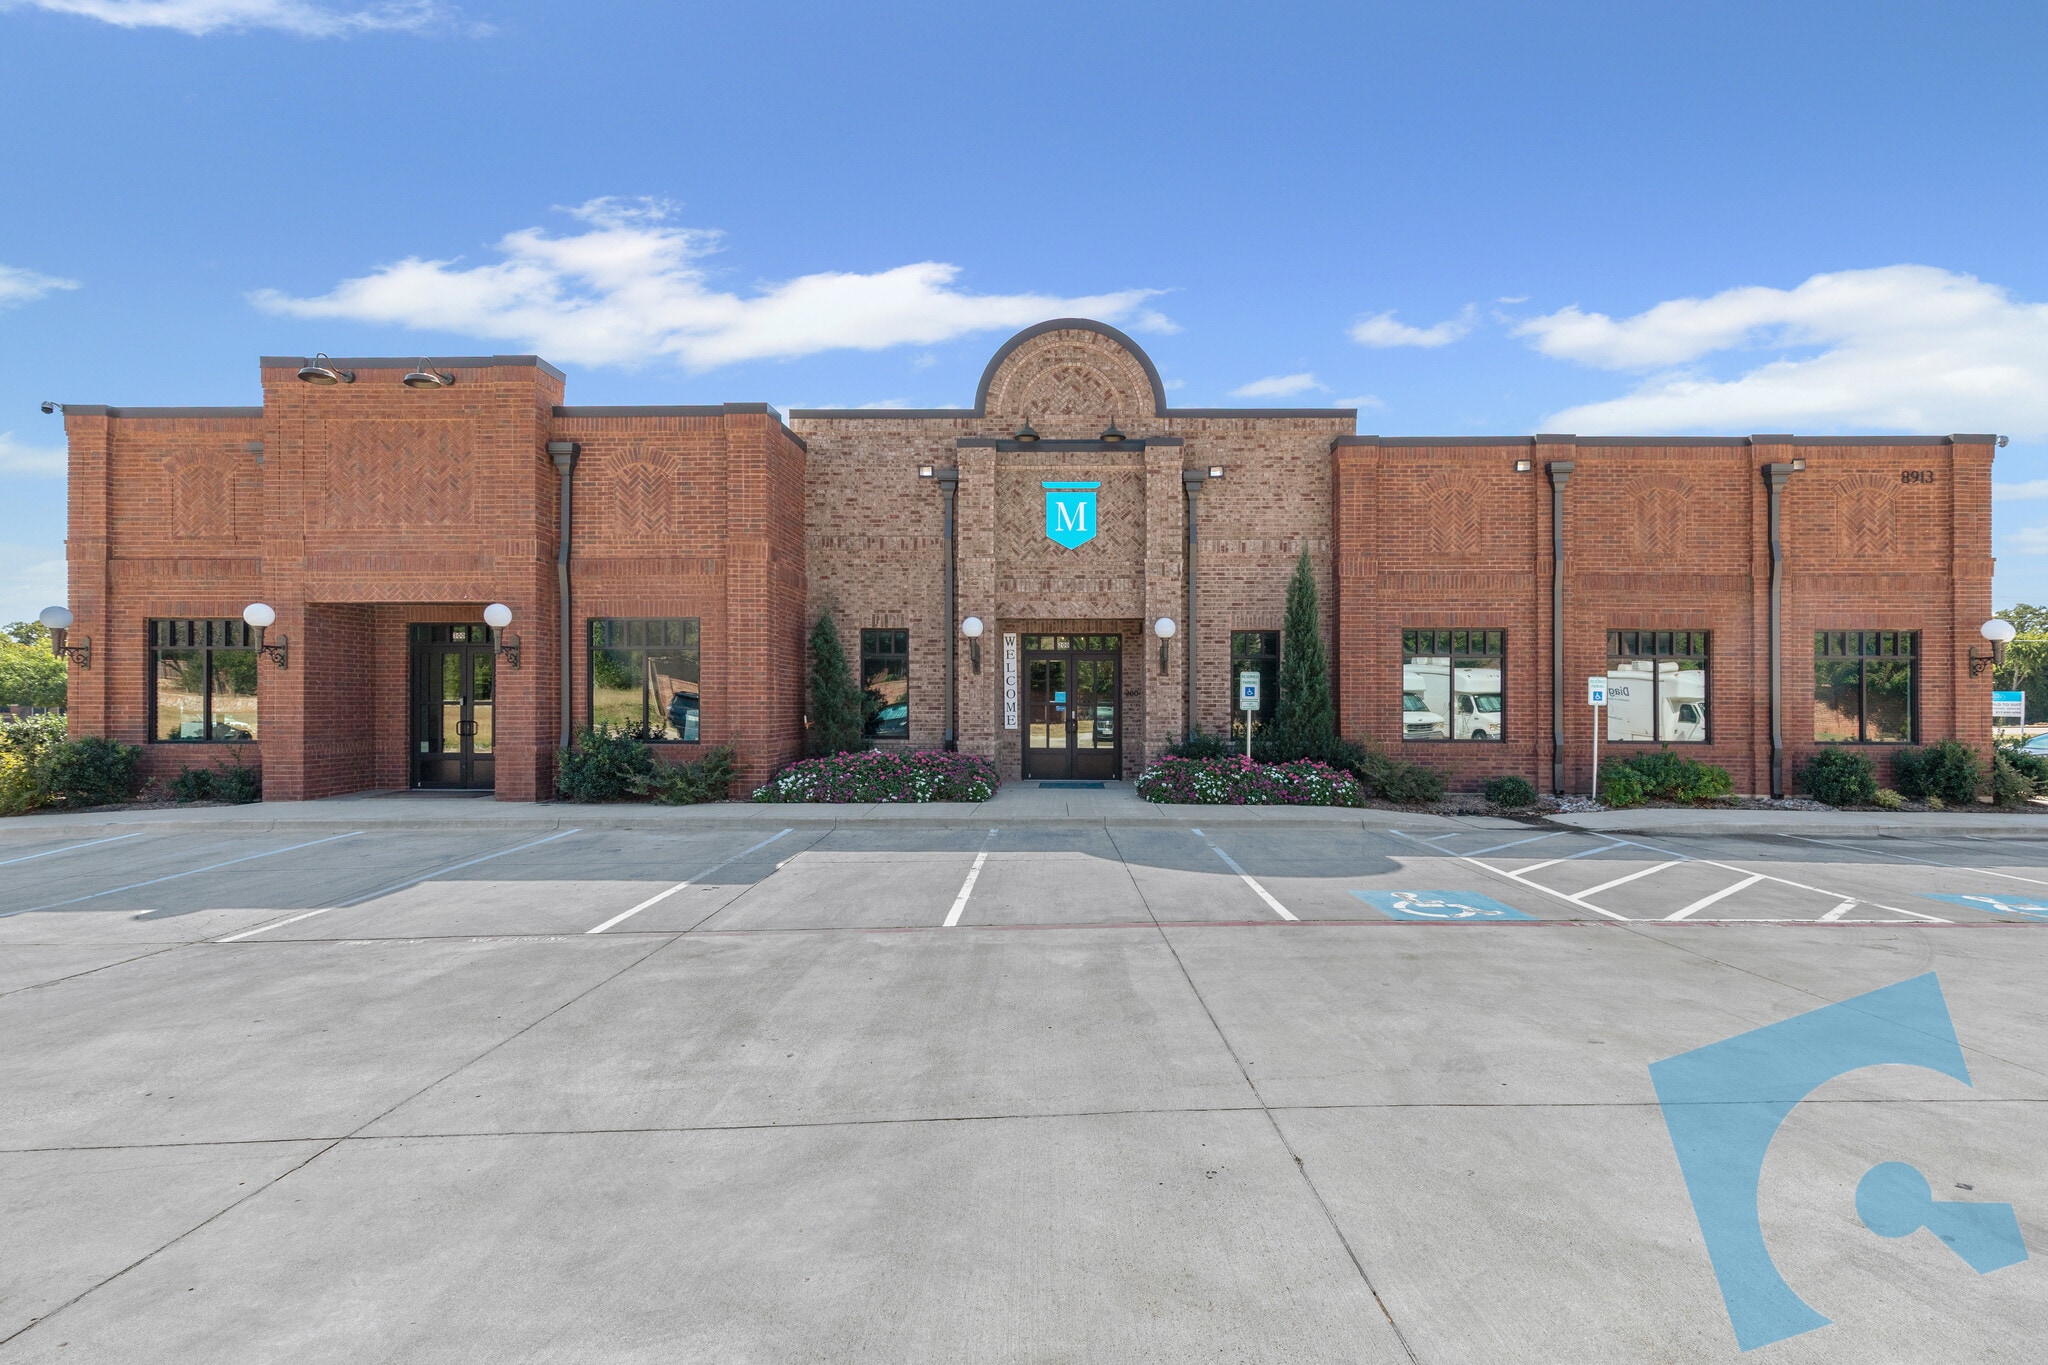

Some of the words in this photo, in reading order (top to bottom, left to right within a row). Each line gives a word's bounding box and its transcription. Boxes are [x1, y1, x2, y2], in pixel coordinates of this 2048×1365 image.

[1901, 470, 1934, 483] 8913
[1055, 501, 1087, 532] M
[1005, 636, 1016, 725] WELCOME
